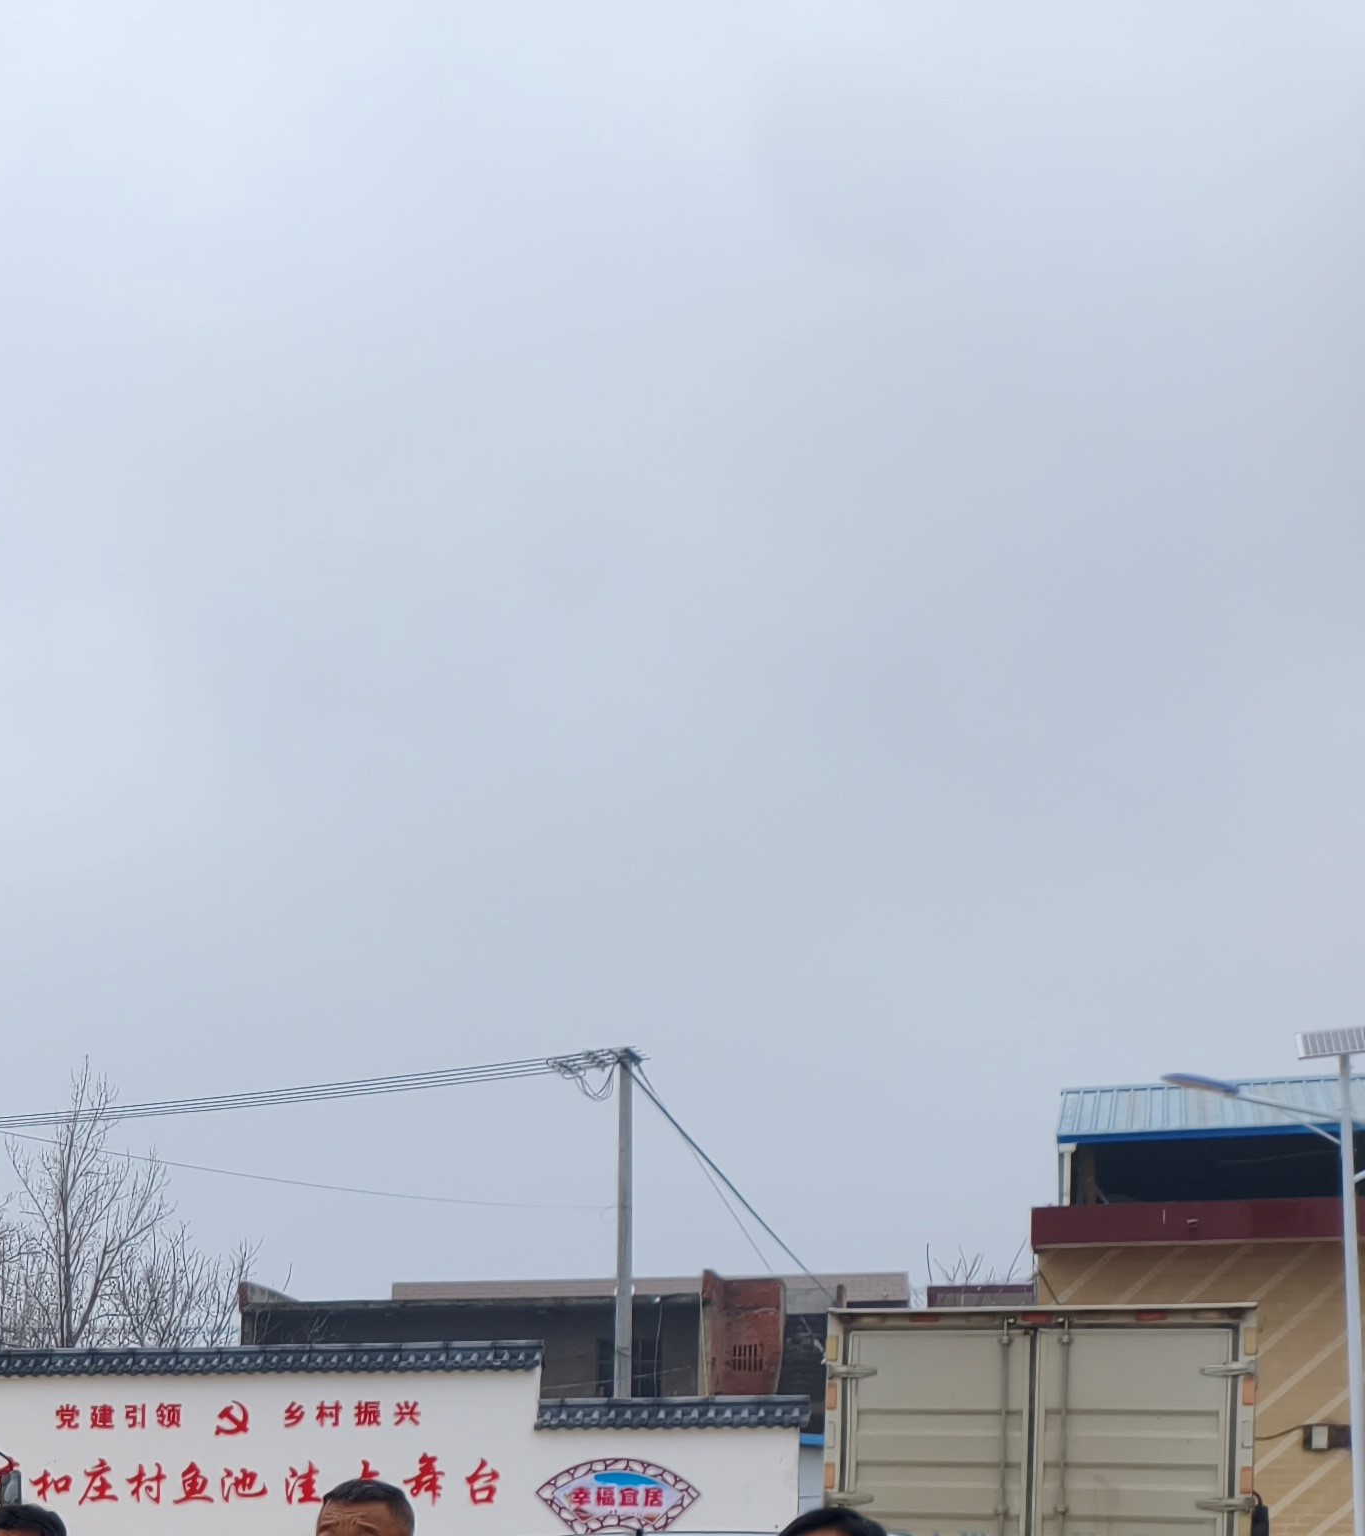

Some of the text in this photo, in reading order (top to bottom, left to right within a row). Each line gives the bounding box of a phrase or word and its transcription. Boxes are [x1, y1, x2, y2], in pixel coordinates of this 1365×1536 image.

[55, 1400, 422, 1430] 党建引领 乡村振兴
[572, 1487, 664, 1508] 幸福宜居
